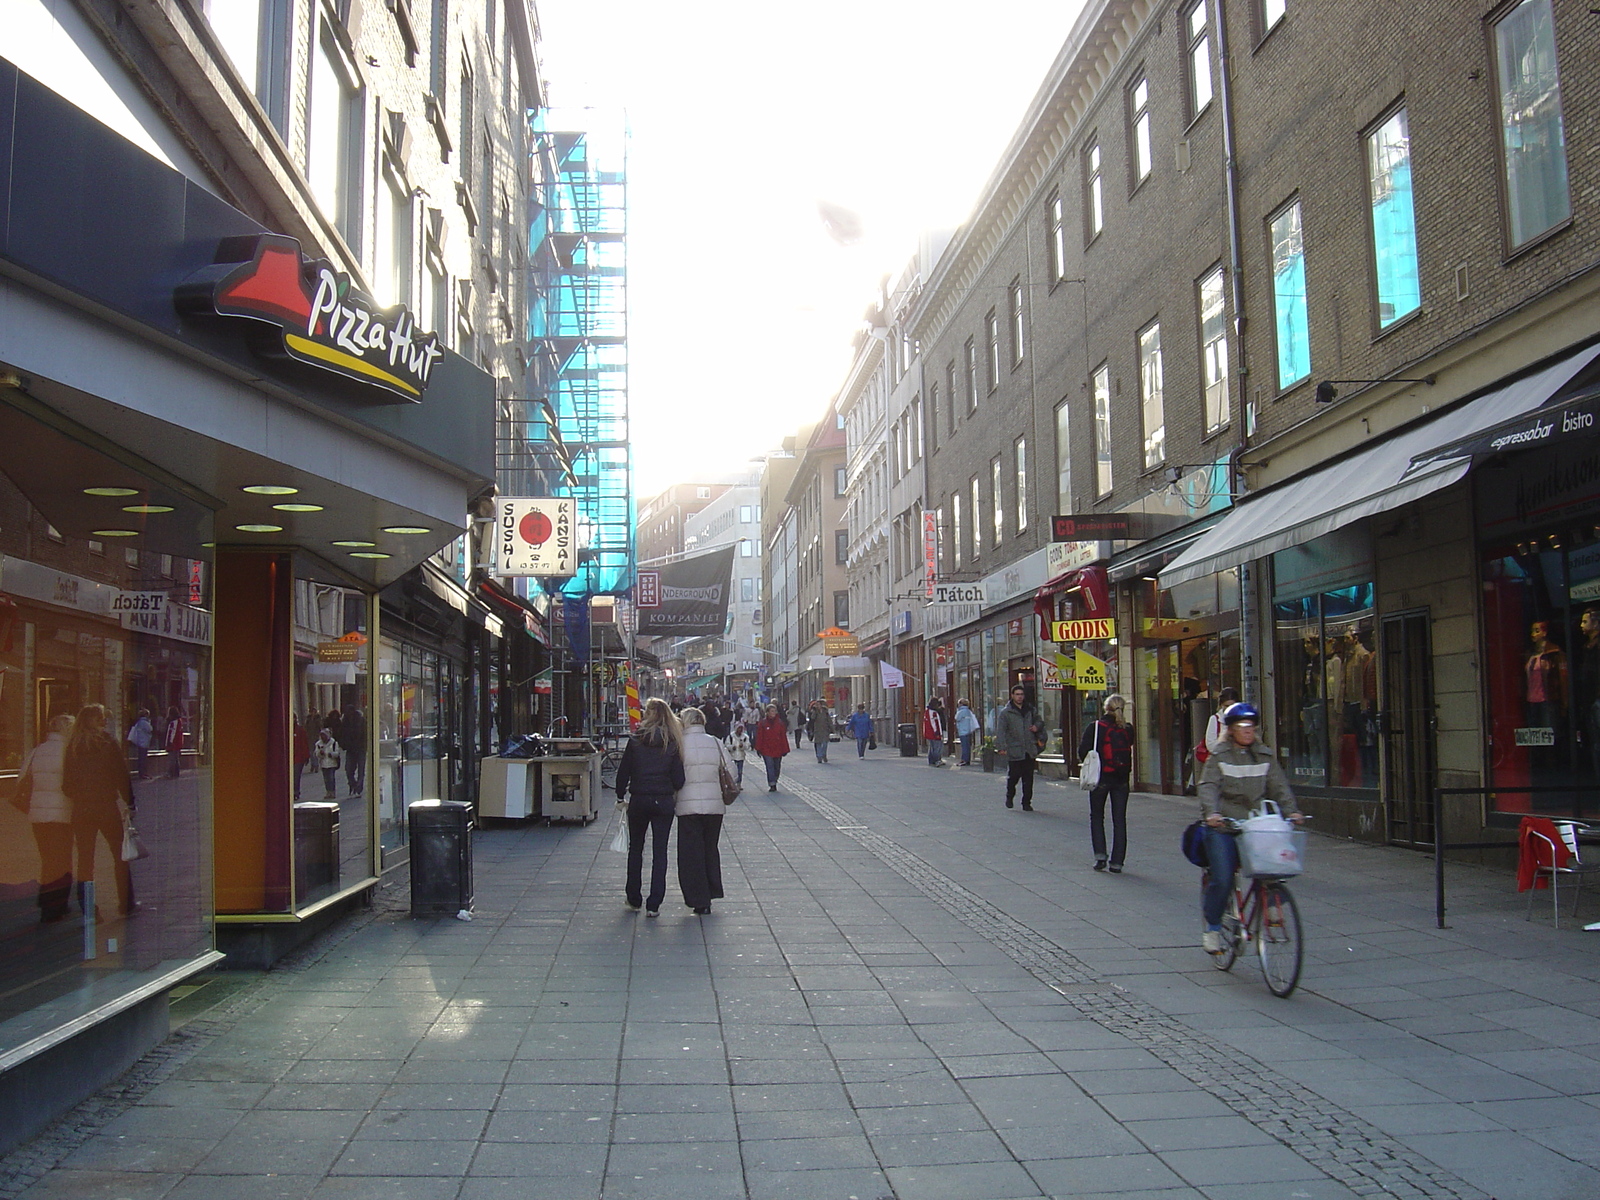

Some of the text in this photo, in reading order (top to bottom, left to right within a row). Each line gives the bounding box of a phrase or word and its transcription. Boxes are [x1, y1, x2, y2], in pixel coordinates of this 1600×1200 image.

[308, 268, 442, 382] Pizza Hut
[1491, 411, 1593, 450] espressobar bistro
[503, 503, 515, 570] SUSHI
[557, 502, 569, 571] KANSAI
[1056, 520, 1076, 536] CD
[662, 588, 720, 600] NDERGROUND
[937, 586, 984, 603] Tátch
[650, 613, 720, 623] KOMPANIET
[1058, 620, 1110, 640] GODIS
[1078, 676, 1105, 684] TRISS
